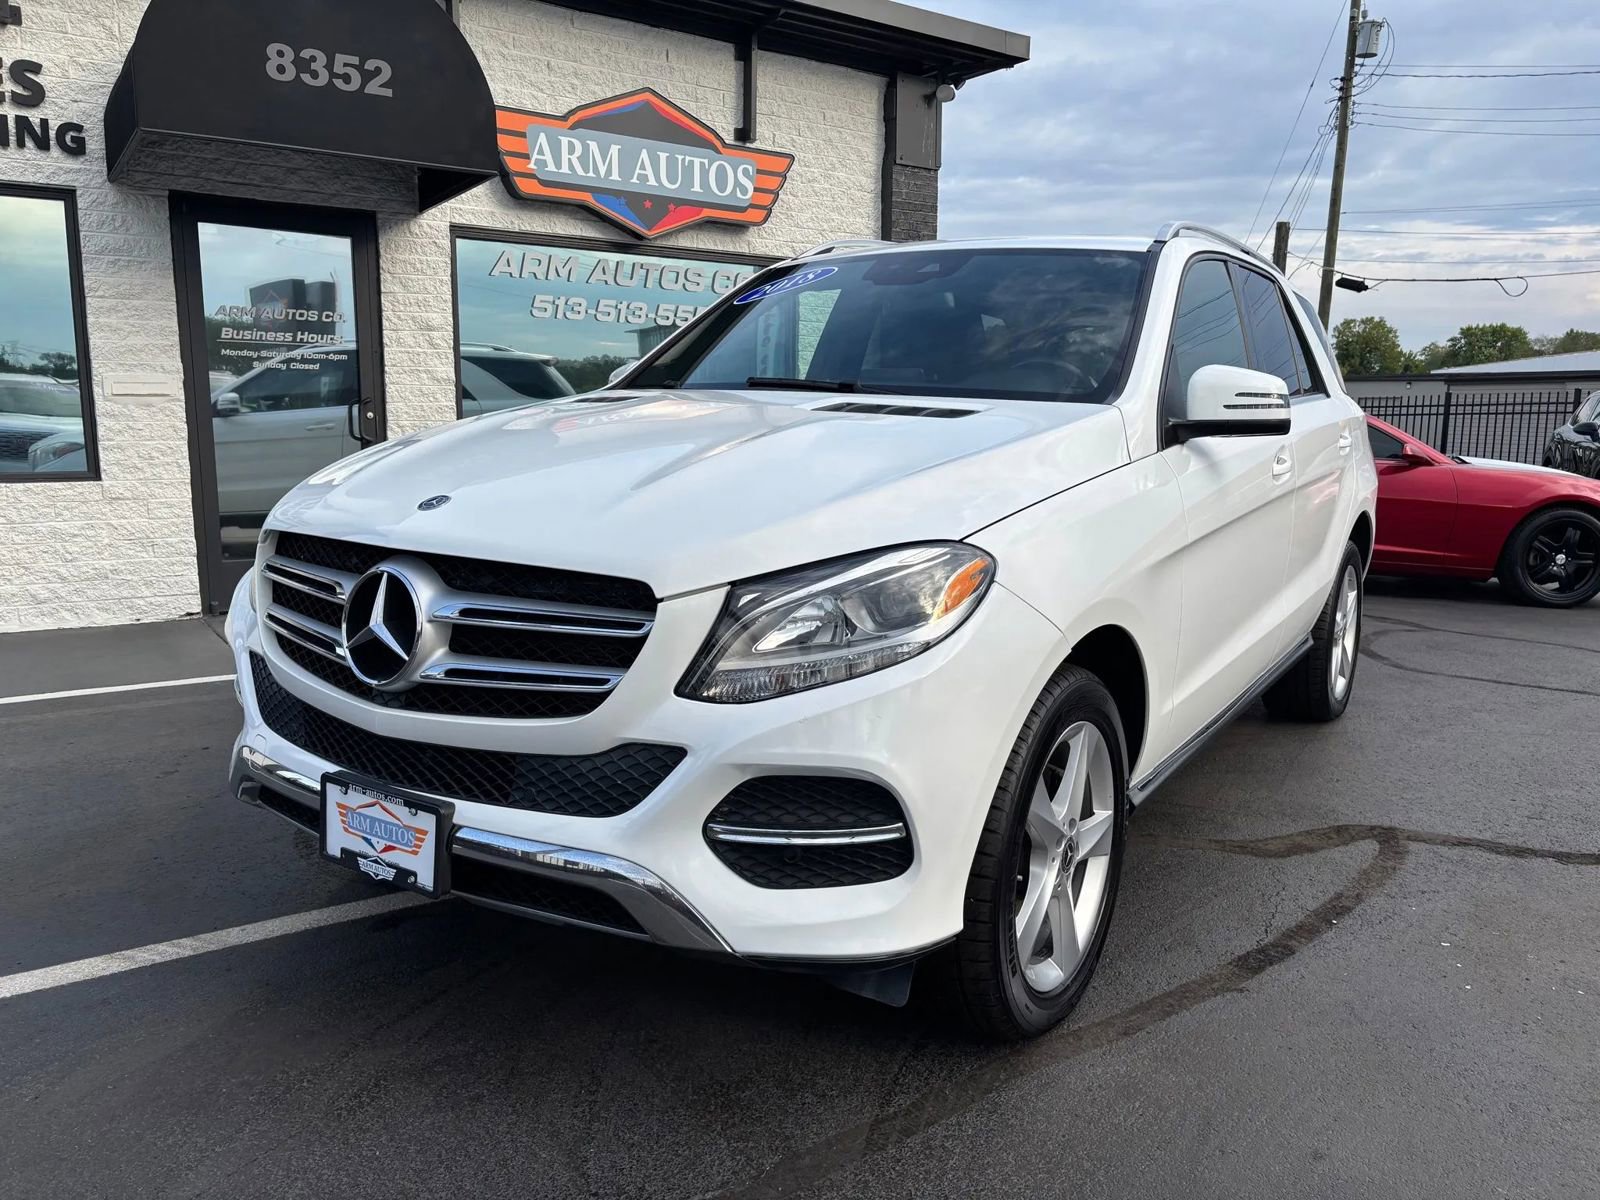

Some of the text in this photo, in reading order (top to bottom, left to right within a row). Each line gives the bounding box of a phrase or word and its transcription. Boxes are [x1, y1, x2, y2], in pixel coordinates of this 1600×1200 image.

[0, 57, 46, 108] S
[265, 43, 393, 97] 8352
[527, 132, 755, 200] ARM AUTOS
[489, 250, 577, 283] ARM
[586, 258, 705, 292] AUTOS
[214, 304, 347, 324] ARM AUTOS CO.
[220, 327, 345, 344] Business Hours:
[221, 348, 348, 361] Monday-Saturday 10am-6pm
[253, 361, 320, 371] Sunday Closed
[349, 783, 404, 806] arm-autos.com
[347, 811, 415, 846] ARM AUTOS
